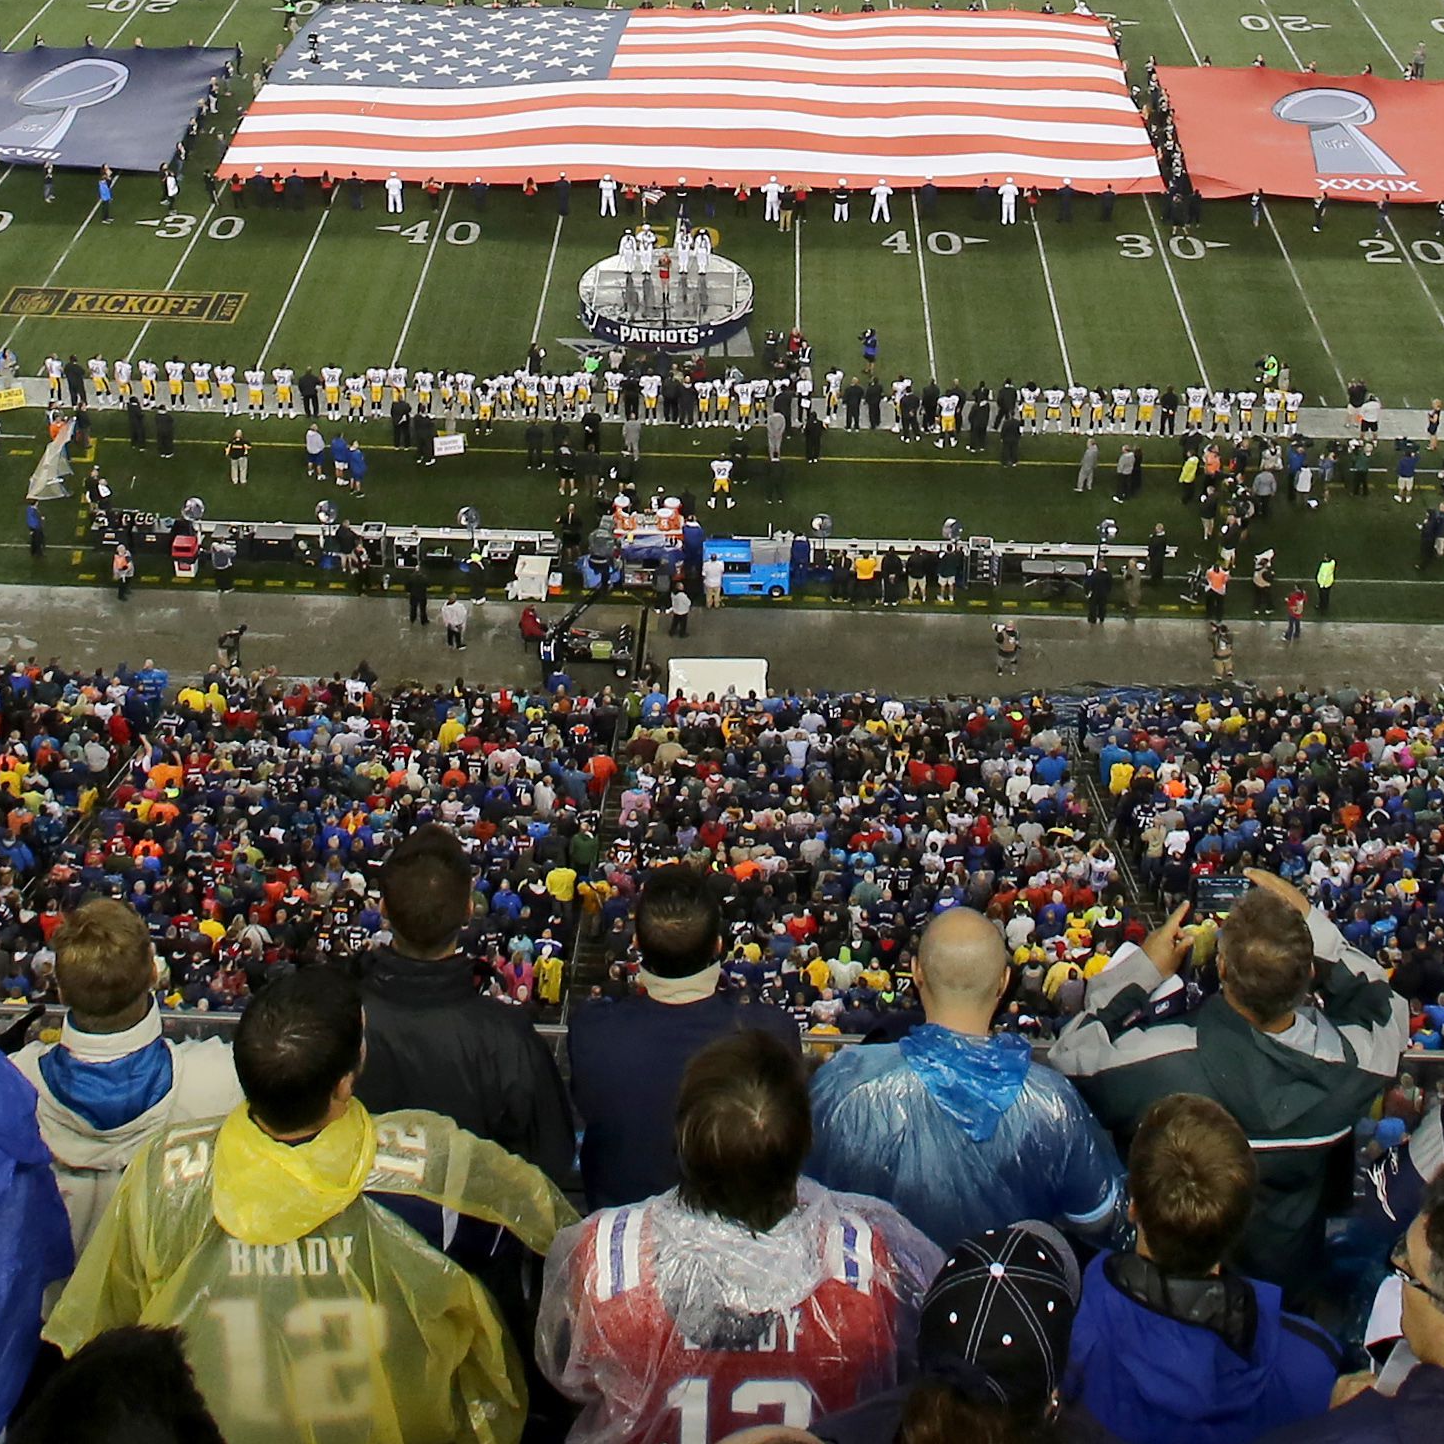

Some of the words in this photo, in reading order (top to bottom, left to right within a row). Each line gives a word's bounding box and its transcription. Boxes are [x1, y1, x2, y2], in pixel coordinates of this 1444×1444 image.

[1315, 178, 1423, 193] XXXIX
[155, 213, 245, 240] 30
[400, 220, 482, 246] 40
[881, 230, 963, 256] 40
[1115, 233, 1206, 260] 30
[68, 294, 204, 316] KICKOFF
[620, 325, 700, 345] PATRIOTS
[227, 1235, 354, 1277] BRADY
[207, 1297, 388, 1422] 12
